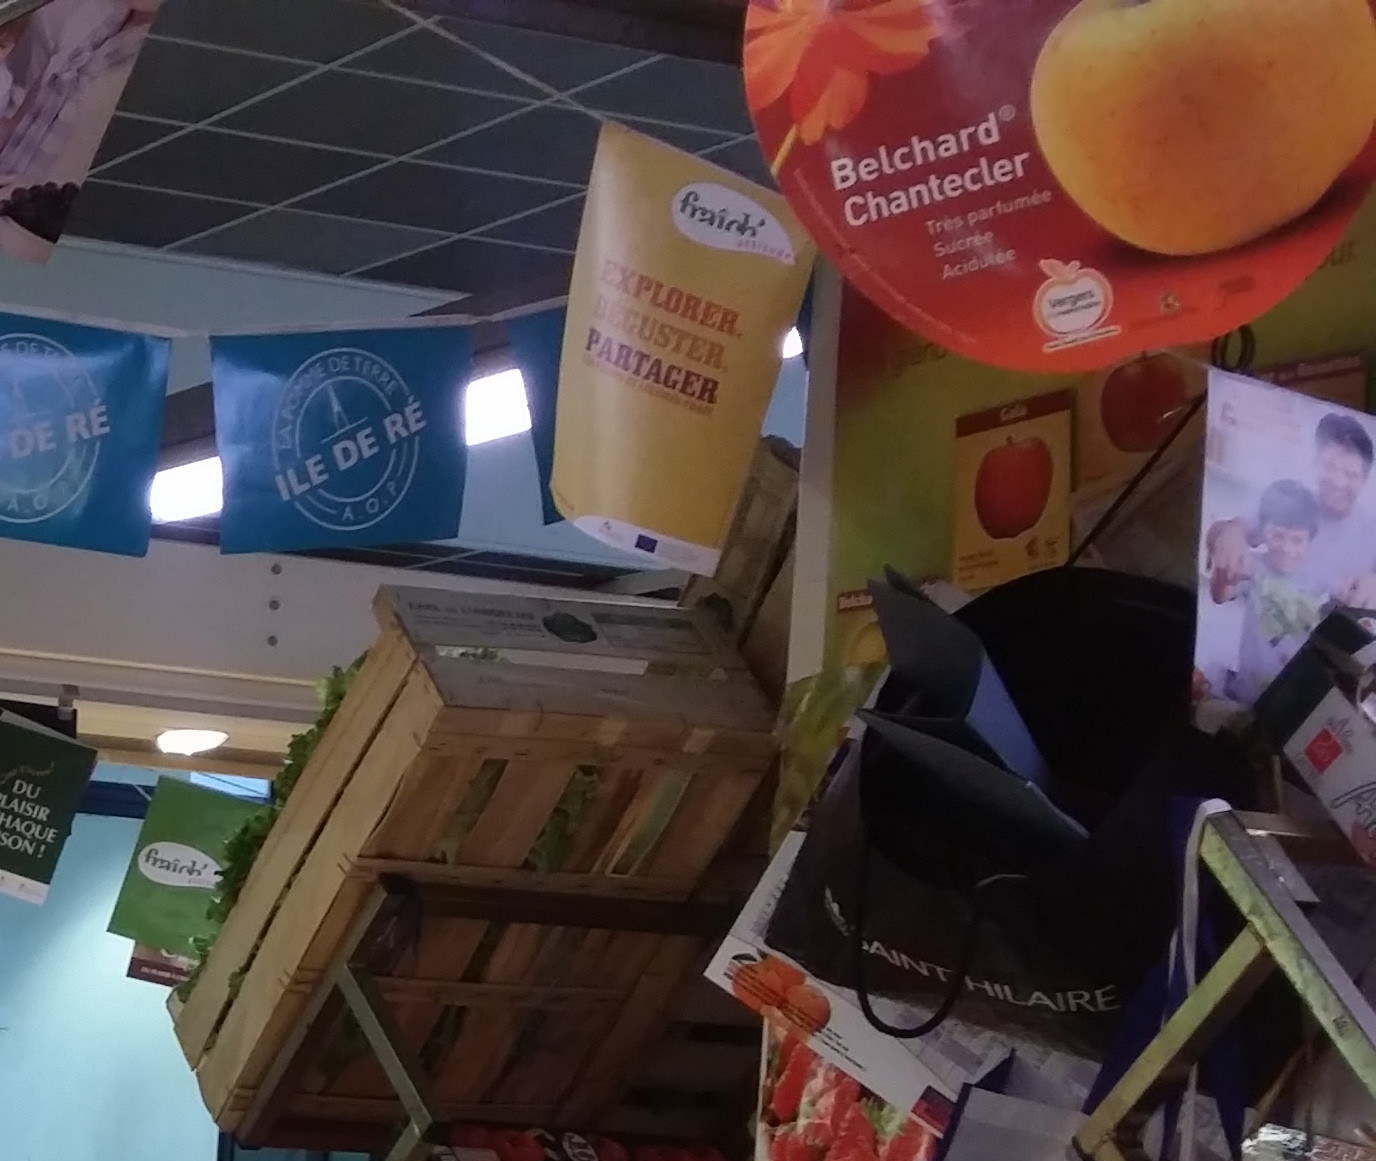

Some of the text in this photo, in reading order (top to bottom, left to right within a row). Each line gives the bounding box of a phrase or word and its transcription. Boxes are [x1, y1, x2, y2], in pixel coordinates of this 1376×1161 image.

[844, 151, 1031, 227] Chantecler
[967, 187, 1053, 228] parfumée
[933, 230, 995, 258] Sucrée
[941, 248, 1018, 281] Acidulée
[327, 355, 351, 373] DE
[352, 356, 399, 397] TERRE
[585, 326, 721, 405] PARTAGER
[8, 420, 57, 460] DE
[65, 397, 111, 442] RÉ
[274, 394, 429, 502] ILE DE RÉ
[12, 779, 43, 800] DU
[860, 940, 1122, 1013] AINT HILAIRE
